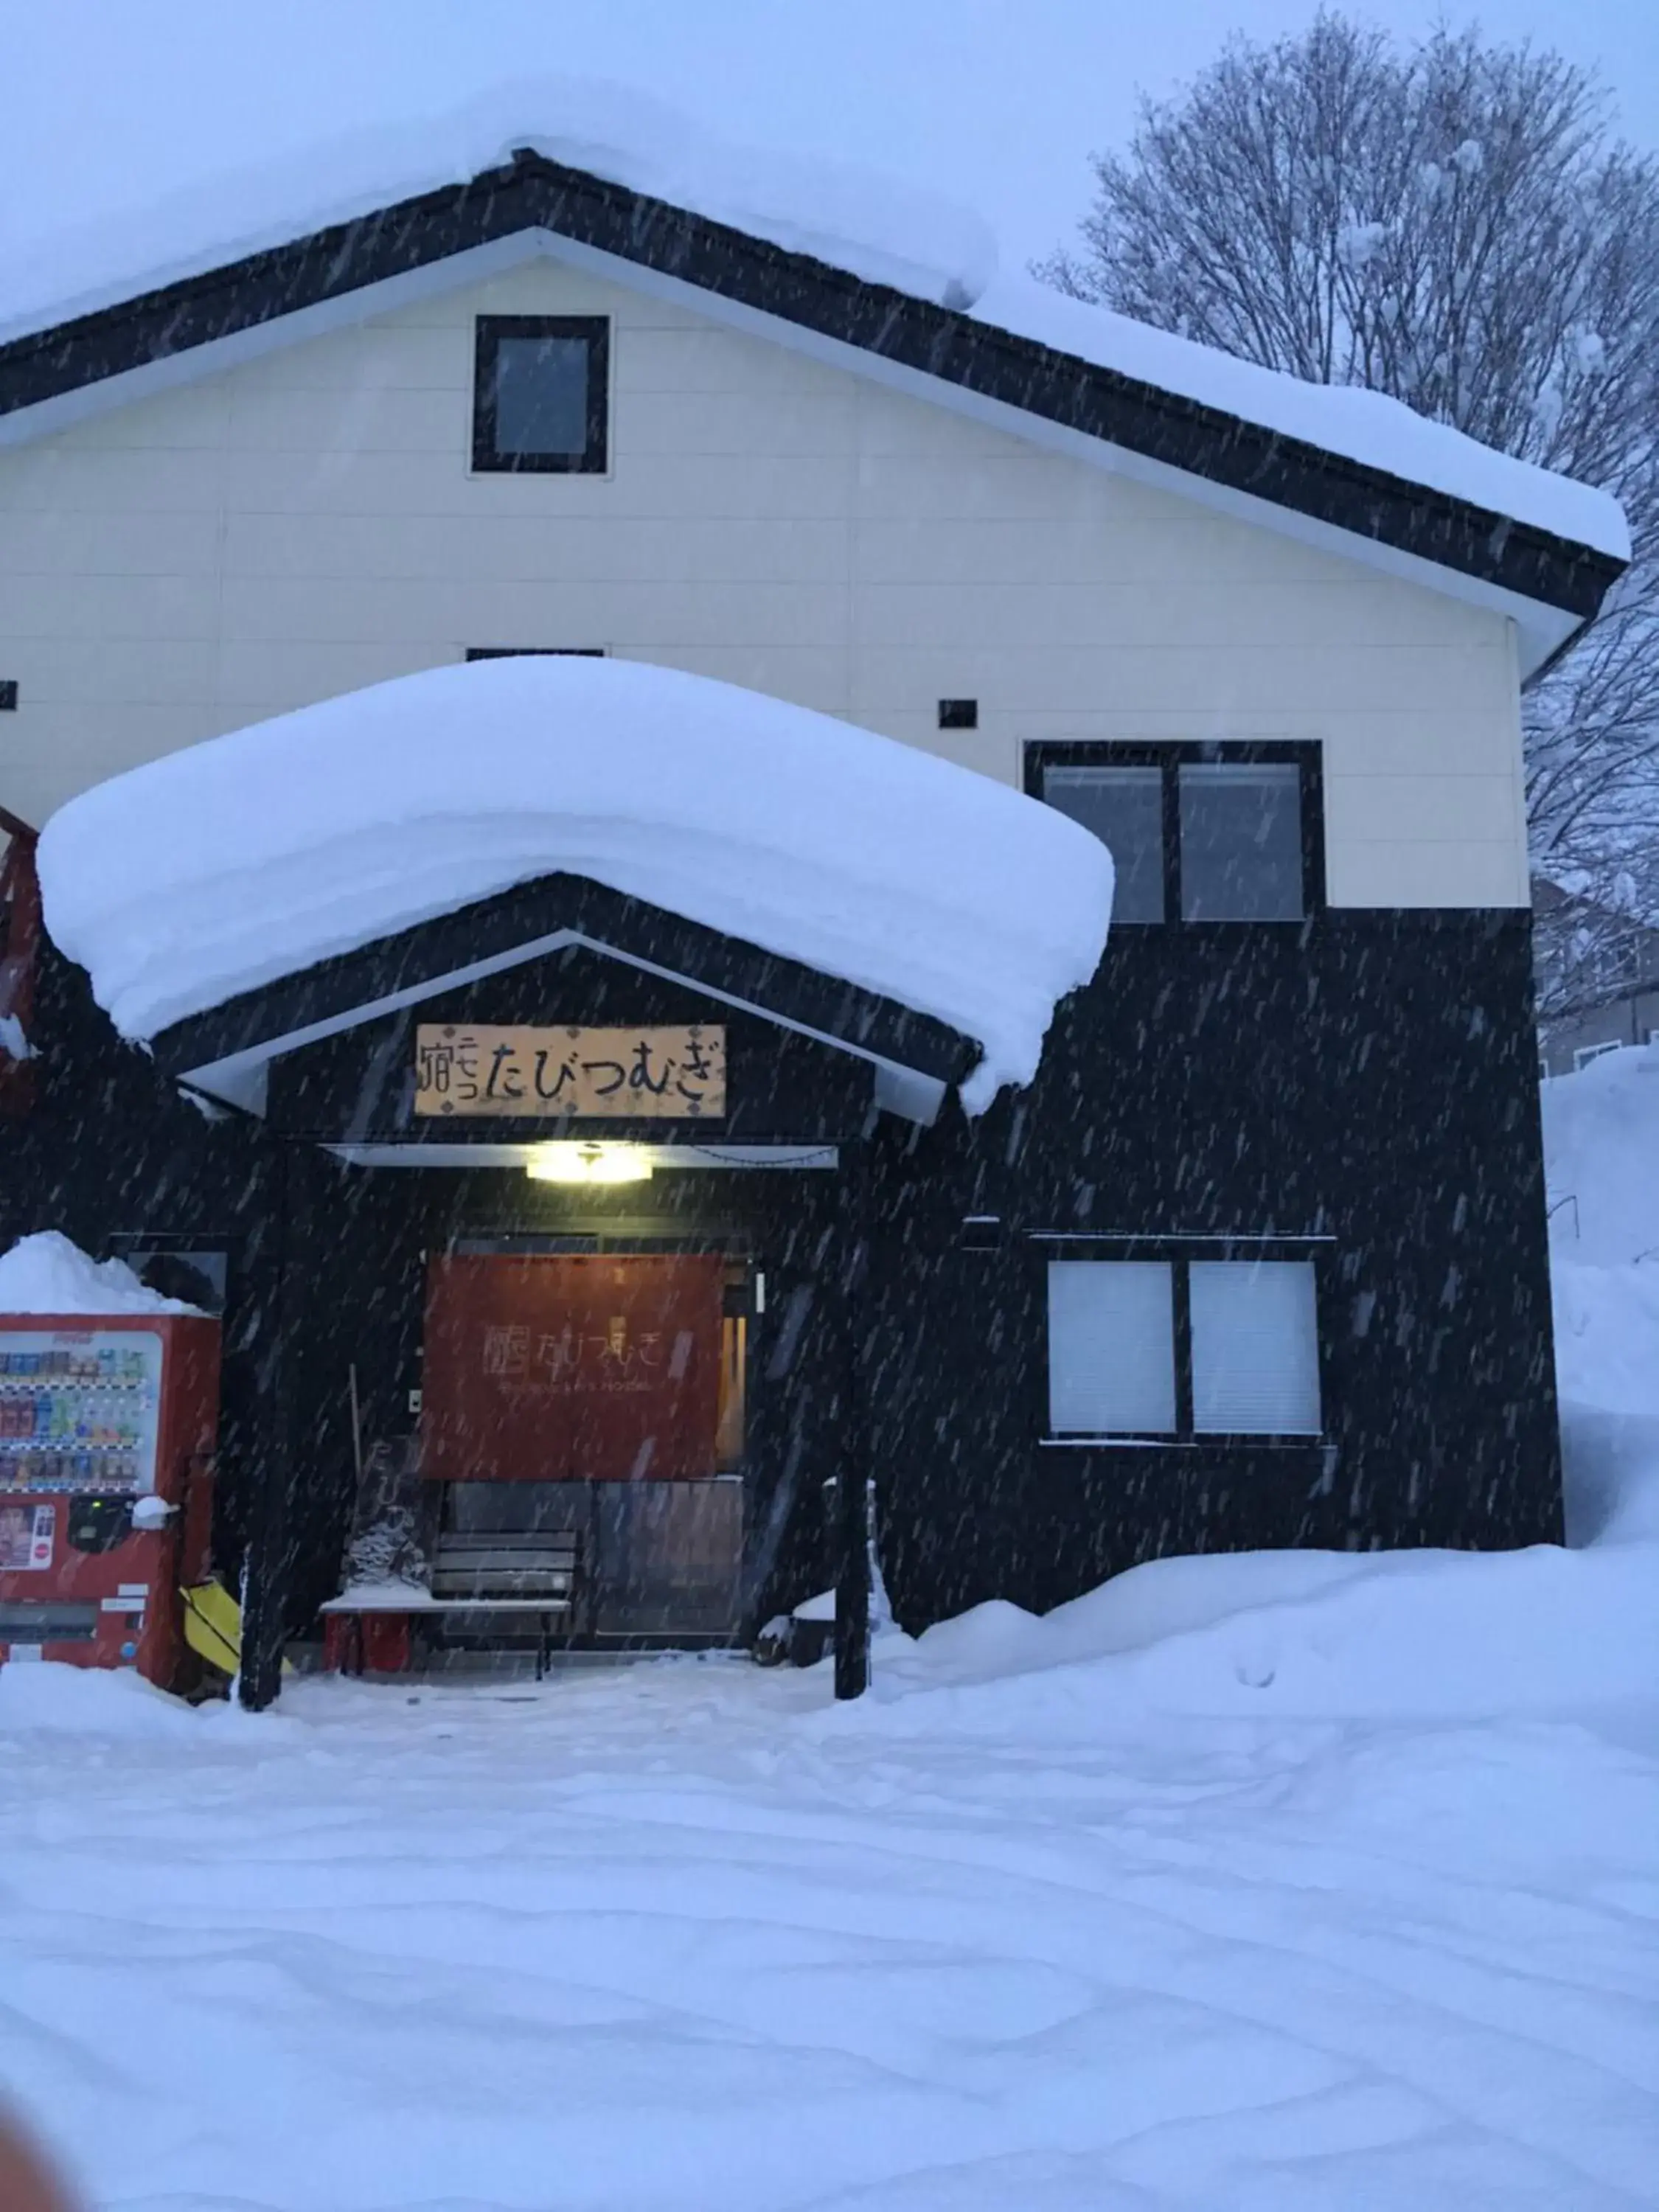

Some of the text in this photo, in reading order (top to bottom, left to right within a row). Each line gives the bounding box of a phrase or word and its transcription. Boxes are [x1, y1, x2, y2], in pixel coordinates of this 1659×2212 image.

[420, 1042, 453, 1093] 宿
[457, 1037, 479, 1099] ニセコ
[486, 1040, 719, 1101] たびつむぎ
